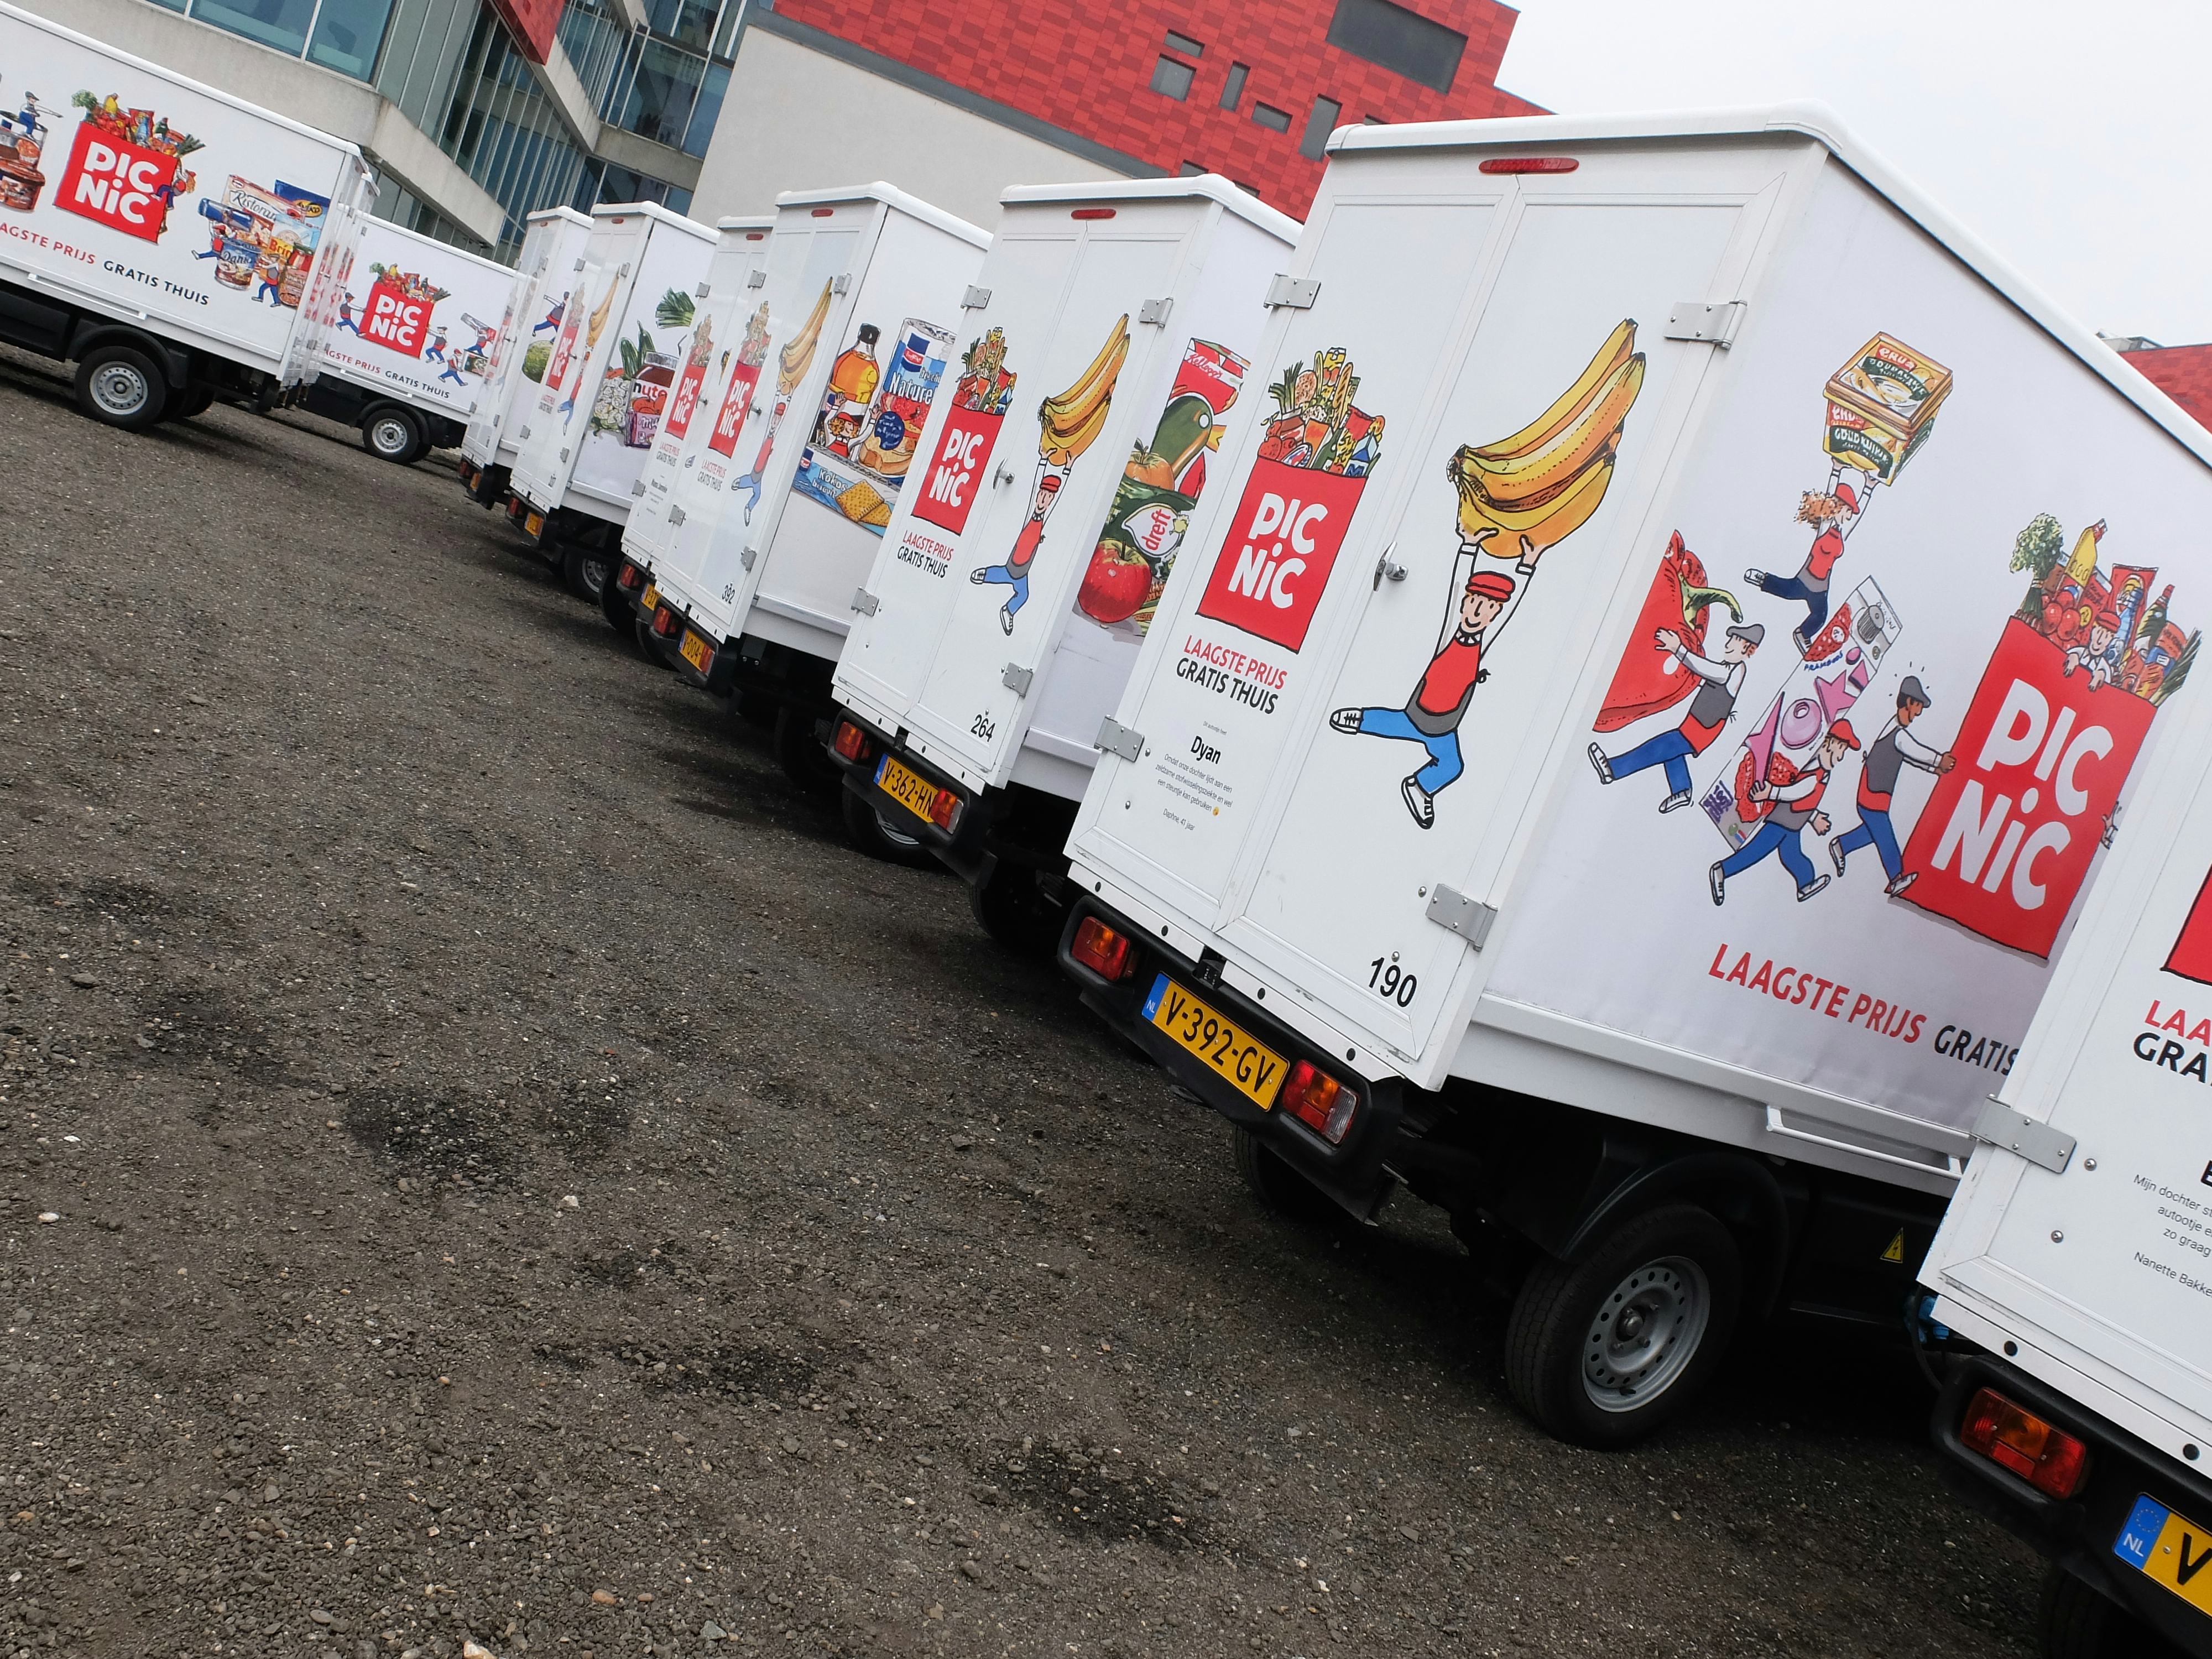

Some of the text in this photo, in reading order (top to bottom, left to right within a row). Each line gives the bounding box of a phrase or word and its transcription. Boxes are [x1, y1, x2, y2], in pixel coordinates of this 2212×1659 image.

[84, 141, 159, 193] PIC
[53, 241, 96, 264] PRIJS
[103, 260, 159, 288] GRATIS
[164, 281, 209, 305] THUIS
[375, 294, 422, 326] PIC
[355, 359, 381, 374] PRIJS
[385, 371, 419, 388] GRATIS
[422, 383, 450, 399] THUIS
[1186, 352, 1224, 379] Kellogg's
[680, 377, 698, 402] PIC
[727, 379, 750, 409] PIC
[889, 371, 935, 405] Nature
[942, 429, 984, 469] PIC
[819, 468, 848, 492] Kokos
[1141, 508, 1171, 551] dreft
[1248, 492, 1328, 554] PIC
[897, 545, 948, 578] GRATIS THUIS
[902, 530, 954, 561] LAAGSTE PRIJS
[722, 584, 735, 604] 392
[1183, 635, 1288, 690] LAAGSTE PRIJS
[1176, 658, 1279, 714] GRATIS THUIS
[971, 714, 996, 743] 264
[1977, 677, 2114, 816] PIC
[1190, 735, 1221, 764] Dyan
[1155, 763, 1176, 778] zeldzame
[1217, 795, 1224, 804] en
[1224, 797, 1233, 808] wel
[1164, 753, 1179, 766] Omdat
[1178, 761, 1189, 771] onze
[1189, 765, 1206, 780] dochter
[1214, 779, 1223, 789] aan
[1223, 784, 1233, 793] een
[1157, 778, 1213, 812] een steuntje kan gebruiken
[1163, 808, 1196, 831] Daphne, 41 jaar
[1368, 957, 1418, 1008] 190
[1146, 999, 1156, 1014] NL
[1708, 943, 2019, 1076] LAAGSTE PRIJS GRATIS
[1164, 990, 1277, 1093] V-392-GV
[2133, 1032, 2212, 1087] GRA
[2133, 1173, 2157, 1192] Mijn
[2158, 1186, 2201, 1211] dochter
[2158, 1206, 2203, 1232] autootje
[2163, 1228, 2211, 1258] zo graag
[2133, 1251, 2212, 1298] Nanette Bakke
[2123, 1533, 2144, 1558] NL
[2177, 1532, 2212, 1586] V
